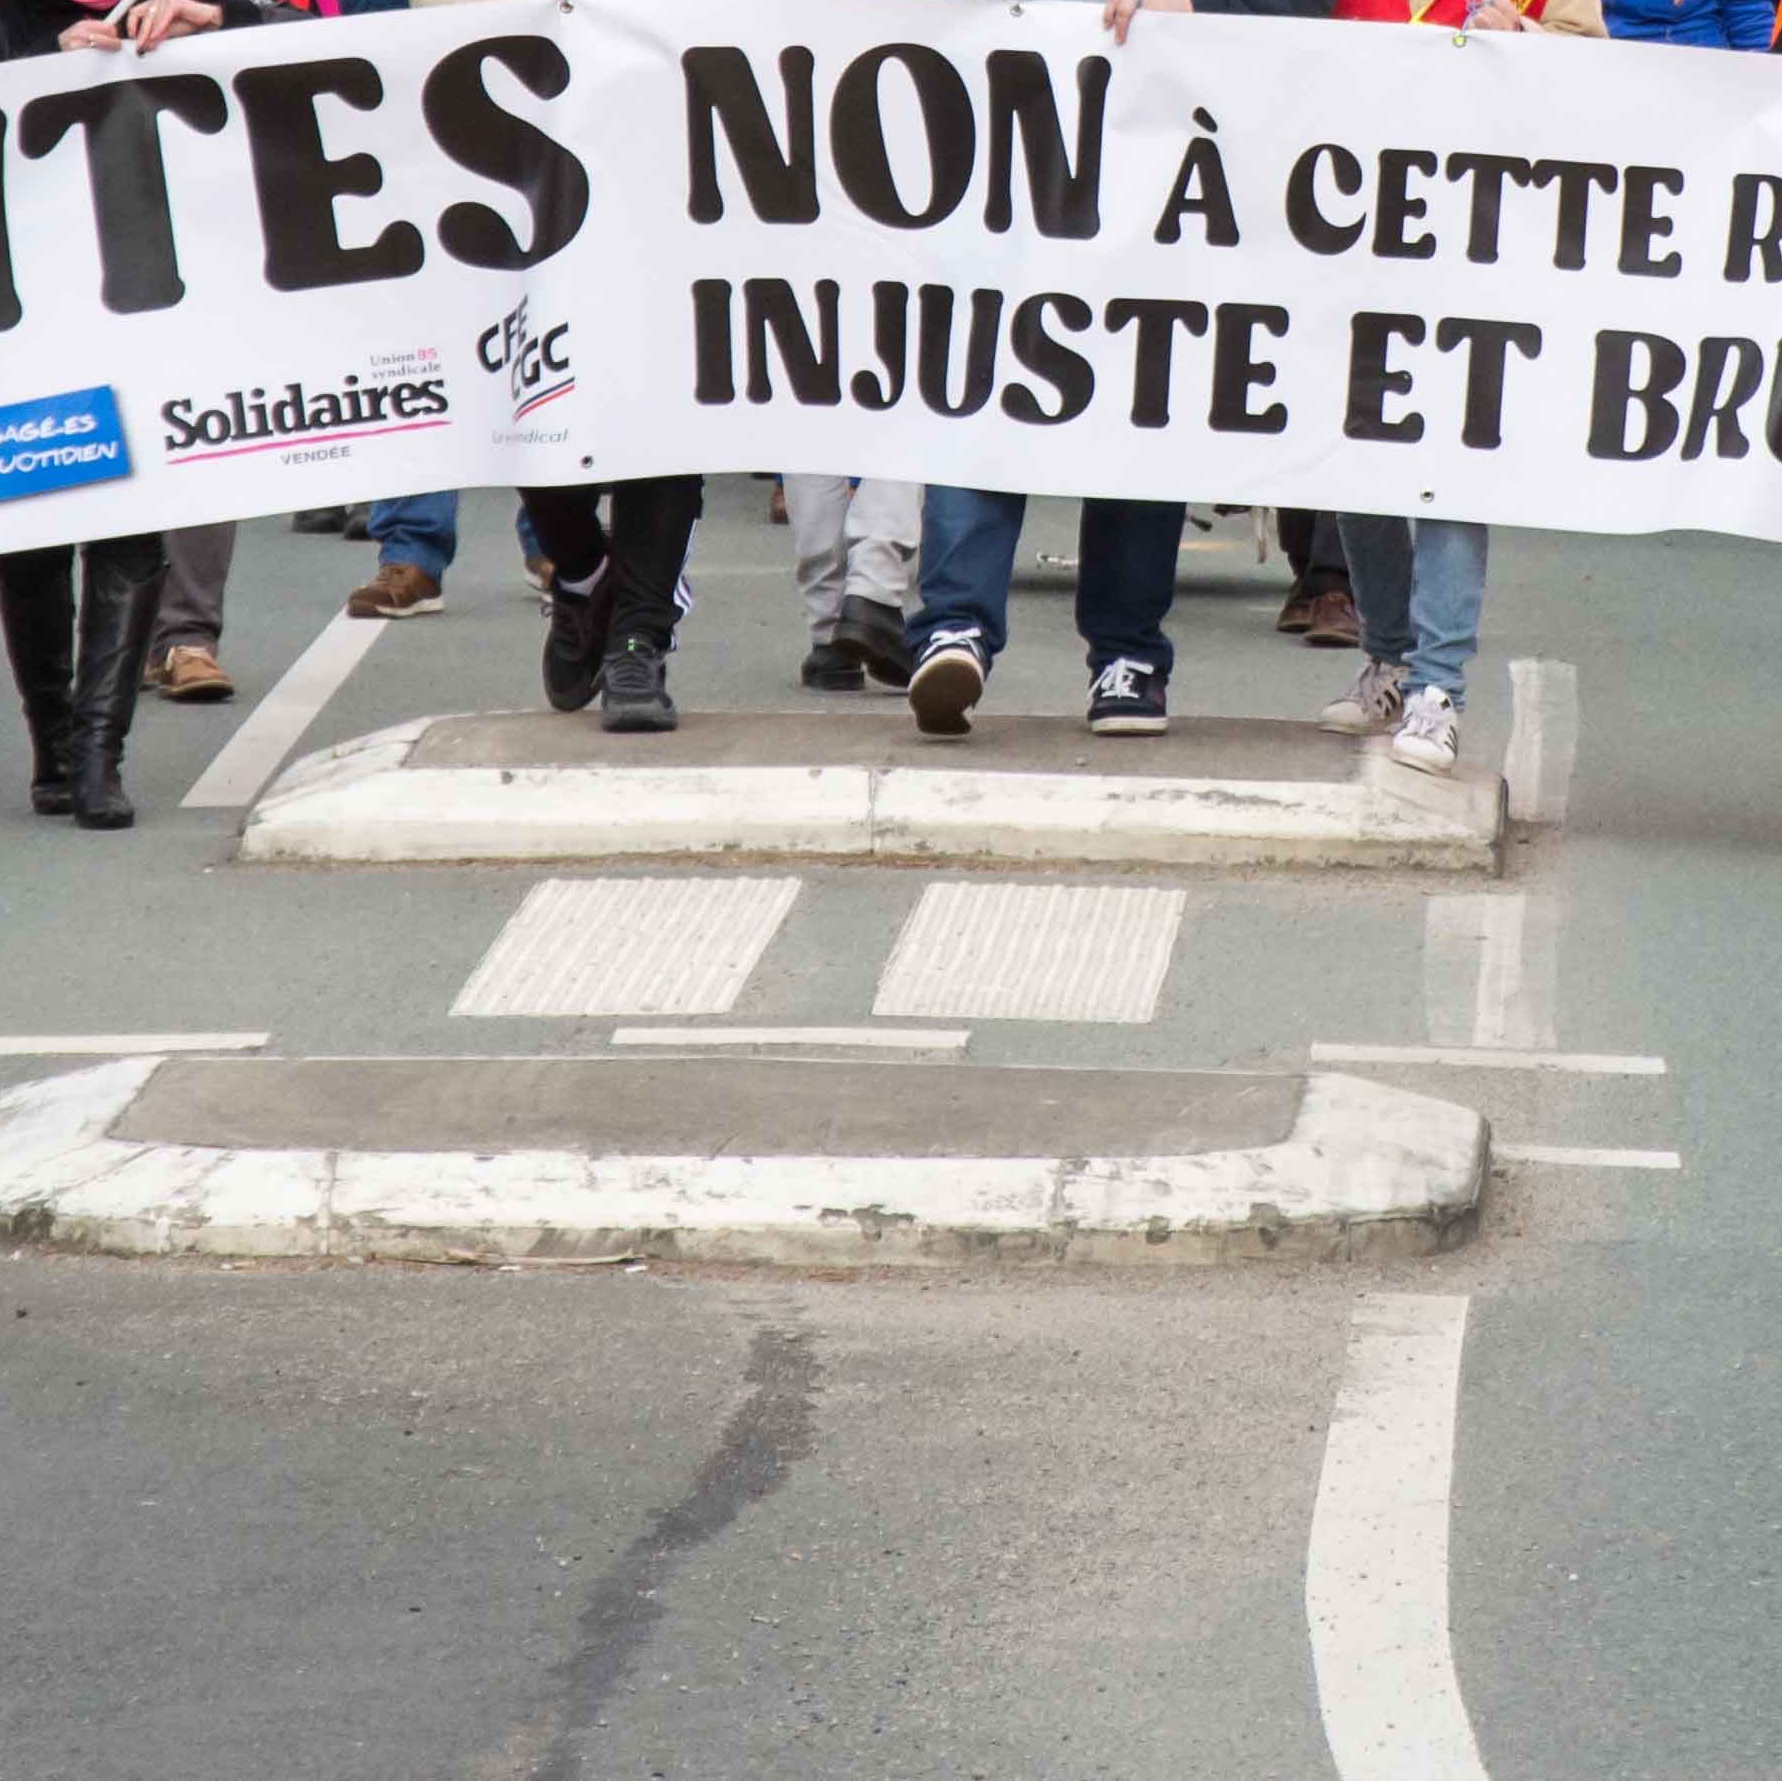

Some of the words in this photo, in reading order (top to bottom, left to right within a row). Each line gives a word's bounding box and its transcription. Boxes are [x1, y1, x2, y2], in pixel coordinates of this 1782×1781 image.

[680, 42, 1112, 240] NON
[1154, 106, 1242, 247] À
[1285, 143, 1685, 278] CETTE
[160, 374, 449, 452] Solidaires
[691, 277, 1290, 435] INJUSTE
[1342, 310, 1543, 451] ET
[280, 443, 352, 467] VENDÉE
